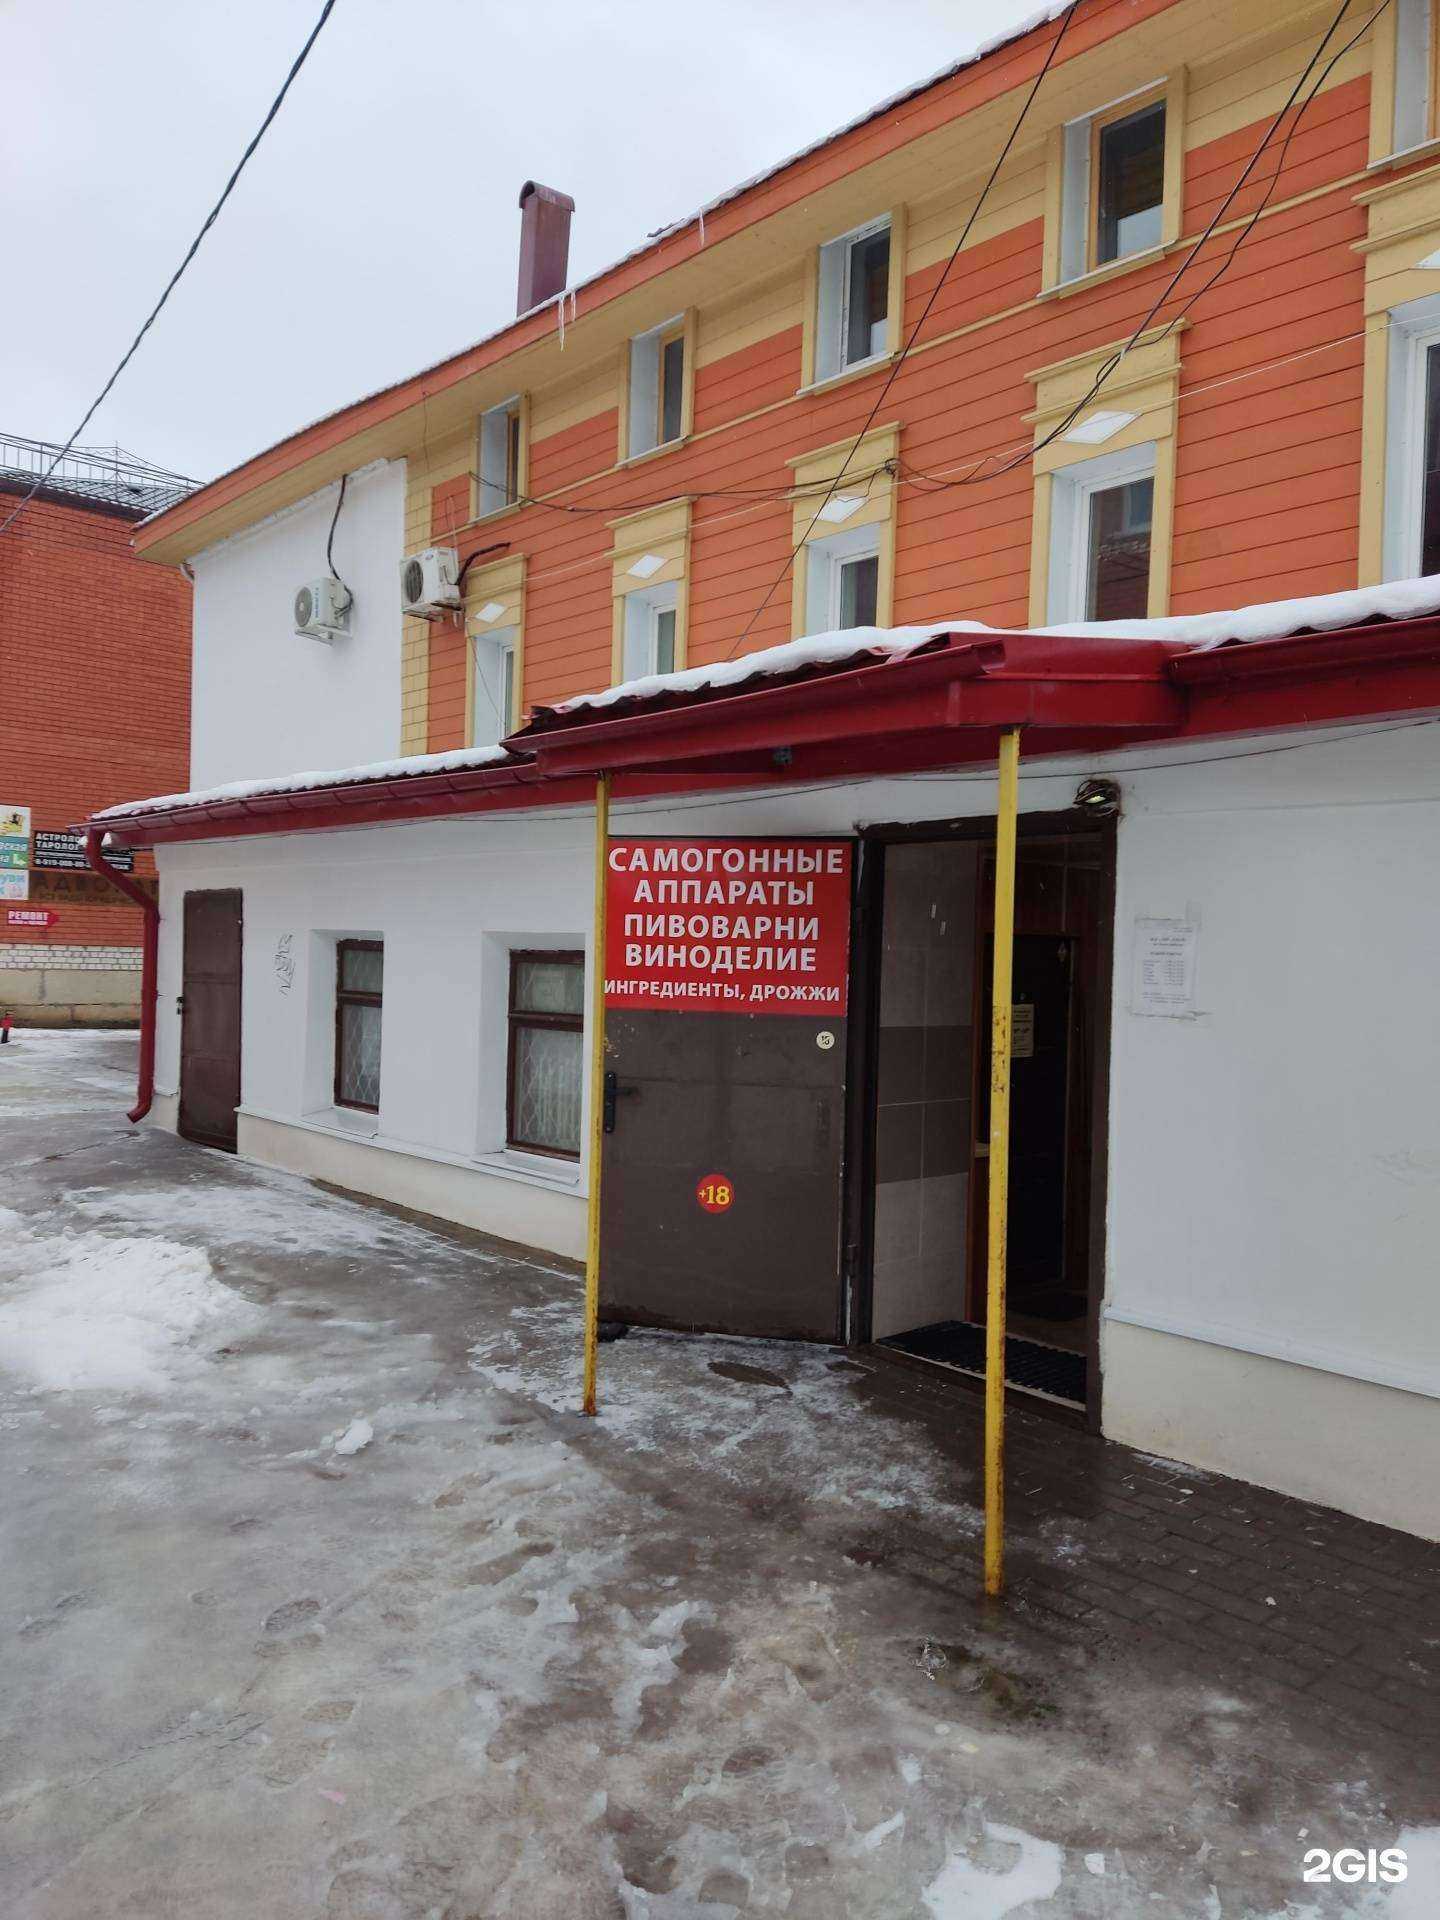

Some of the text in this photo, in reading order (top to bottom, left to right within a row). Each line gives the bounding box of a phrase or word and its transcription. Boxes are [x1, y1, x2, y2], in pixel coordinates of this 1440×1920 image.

[608, 847, 844, 874] САМОГОННЫЕ
[633, 879, 814, 905] АППАРАТЫ
[8, 910, 49, 921] РЕМОНТ
[624, 914, 819, 941] ПИВОВАРНИ
[625, 943, 817, 974] ВИНОДЕЛИЕ
[604, 979, 840, 1002] ИНГРЕДИЕНТЫ, ДРОЖЖИ
[698, 1185, 730, 1205] +18
